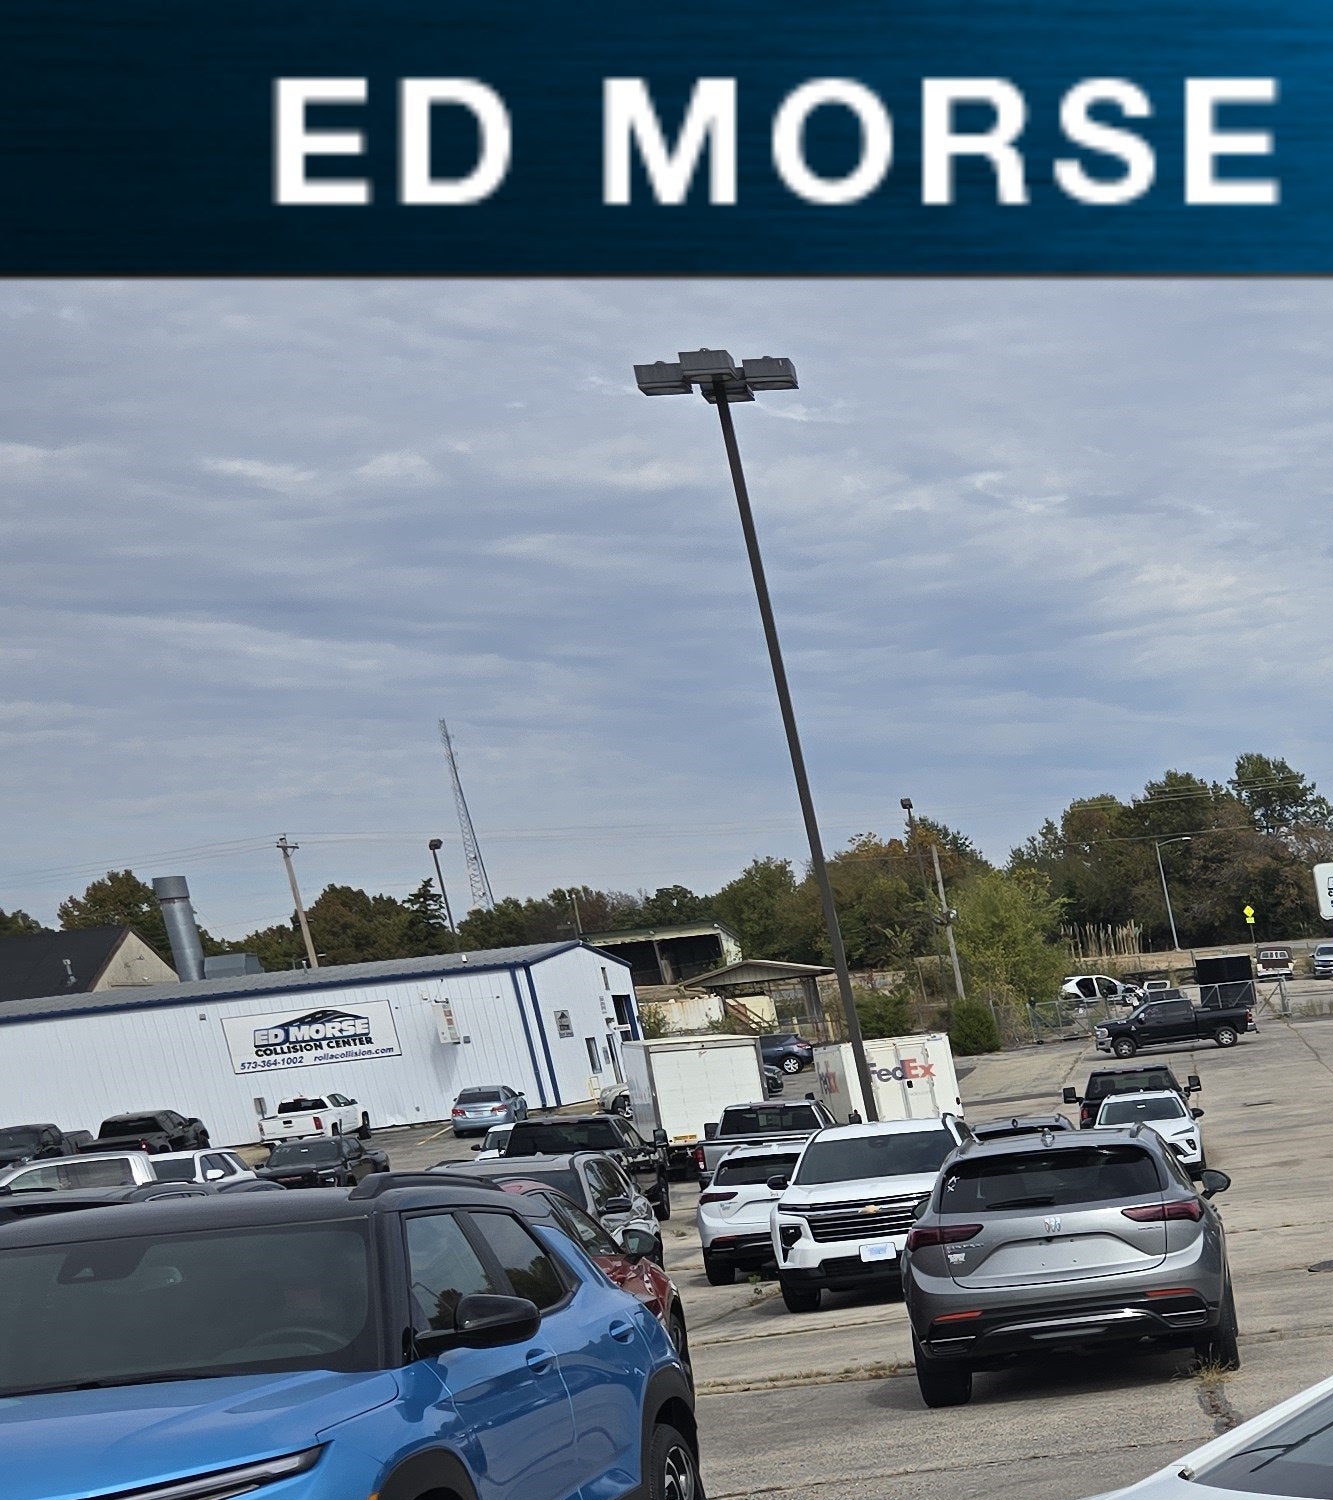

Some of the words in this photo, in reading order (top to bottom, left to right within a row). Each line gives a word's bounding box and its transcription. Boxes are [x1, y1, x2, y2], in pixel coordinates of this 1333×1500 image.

[254, 1028, 286, 1046] ED
[288, 1018, 370, 1042] MORSE
[240, 1056, 304, 1070] 573-364-1002
[313, 1047, 394, 1062] rollacollision.com
[255, 1042, 323, 1058] COLLISION
[327, 1036, 374, 1049] CENTER
